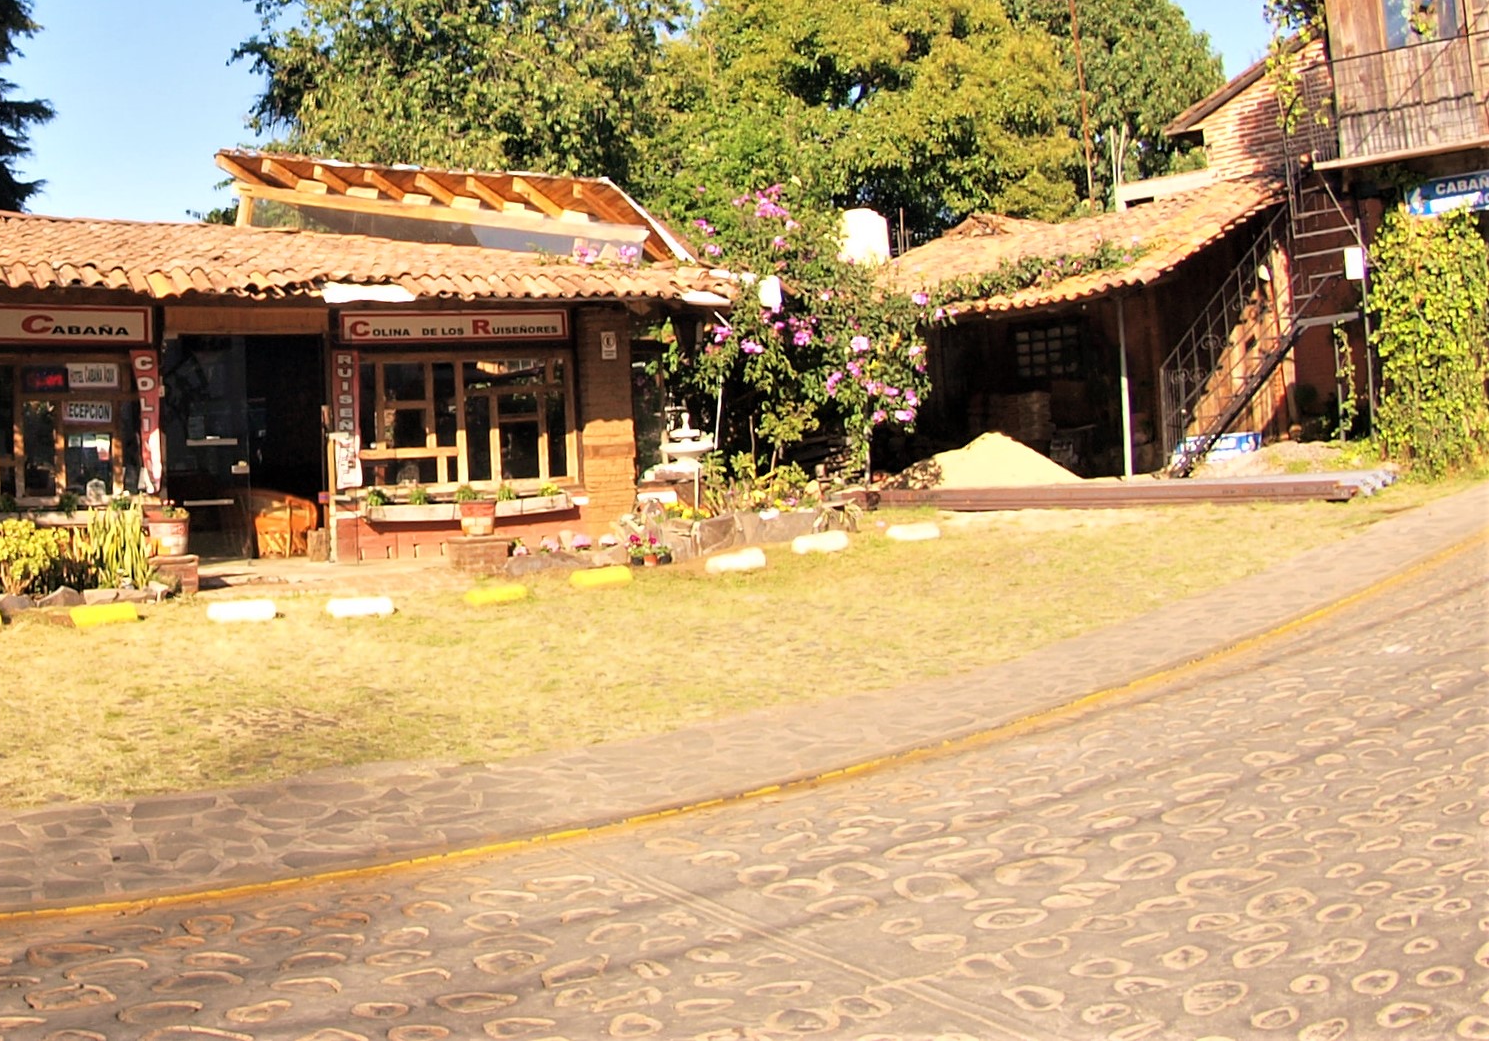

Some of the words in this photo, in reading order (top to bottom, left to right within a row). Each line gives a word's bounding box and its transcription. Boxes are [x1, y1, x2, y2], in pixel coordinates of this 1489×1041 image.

[1435, 175, 1489, 195] CABAÑ
[21, 314, 129, 336] CABAÑA
[350, 320, 410, 337] COLINA
[421, 327, 437, 336] DE
[441, 327, 464, 336] LOS
[471, 319, 558, 336] RUISEÑORES
[134, 356, 157, 479] COLI
